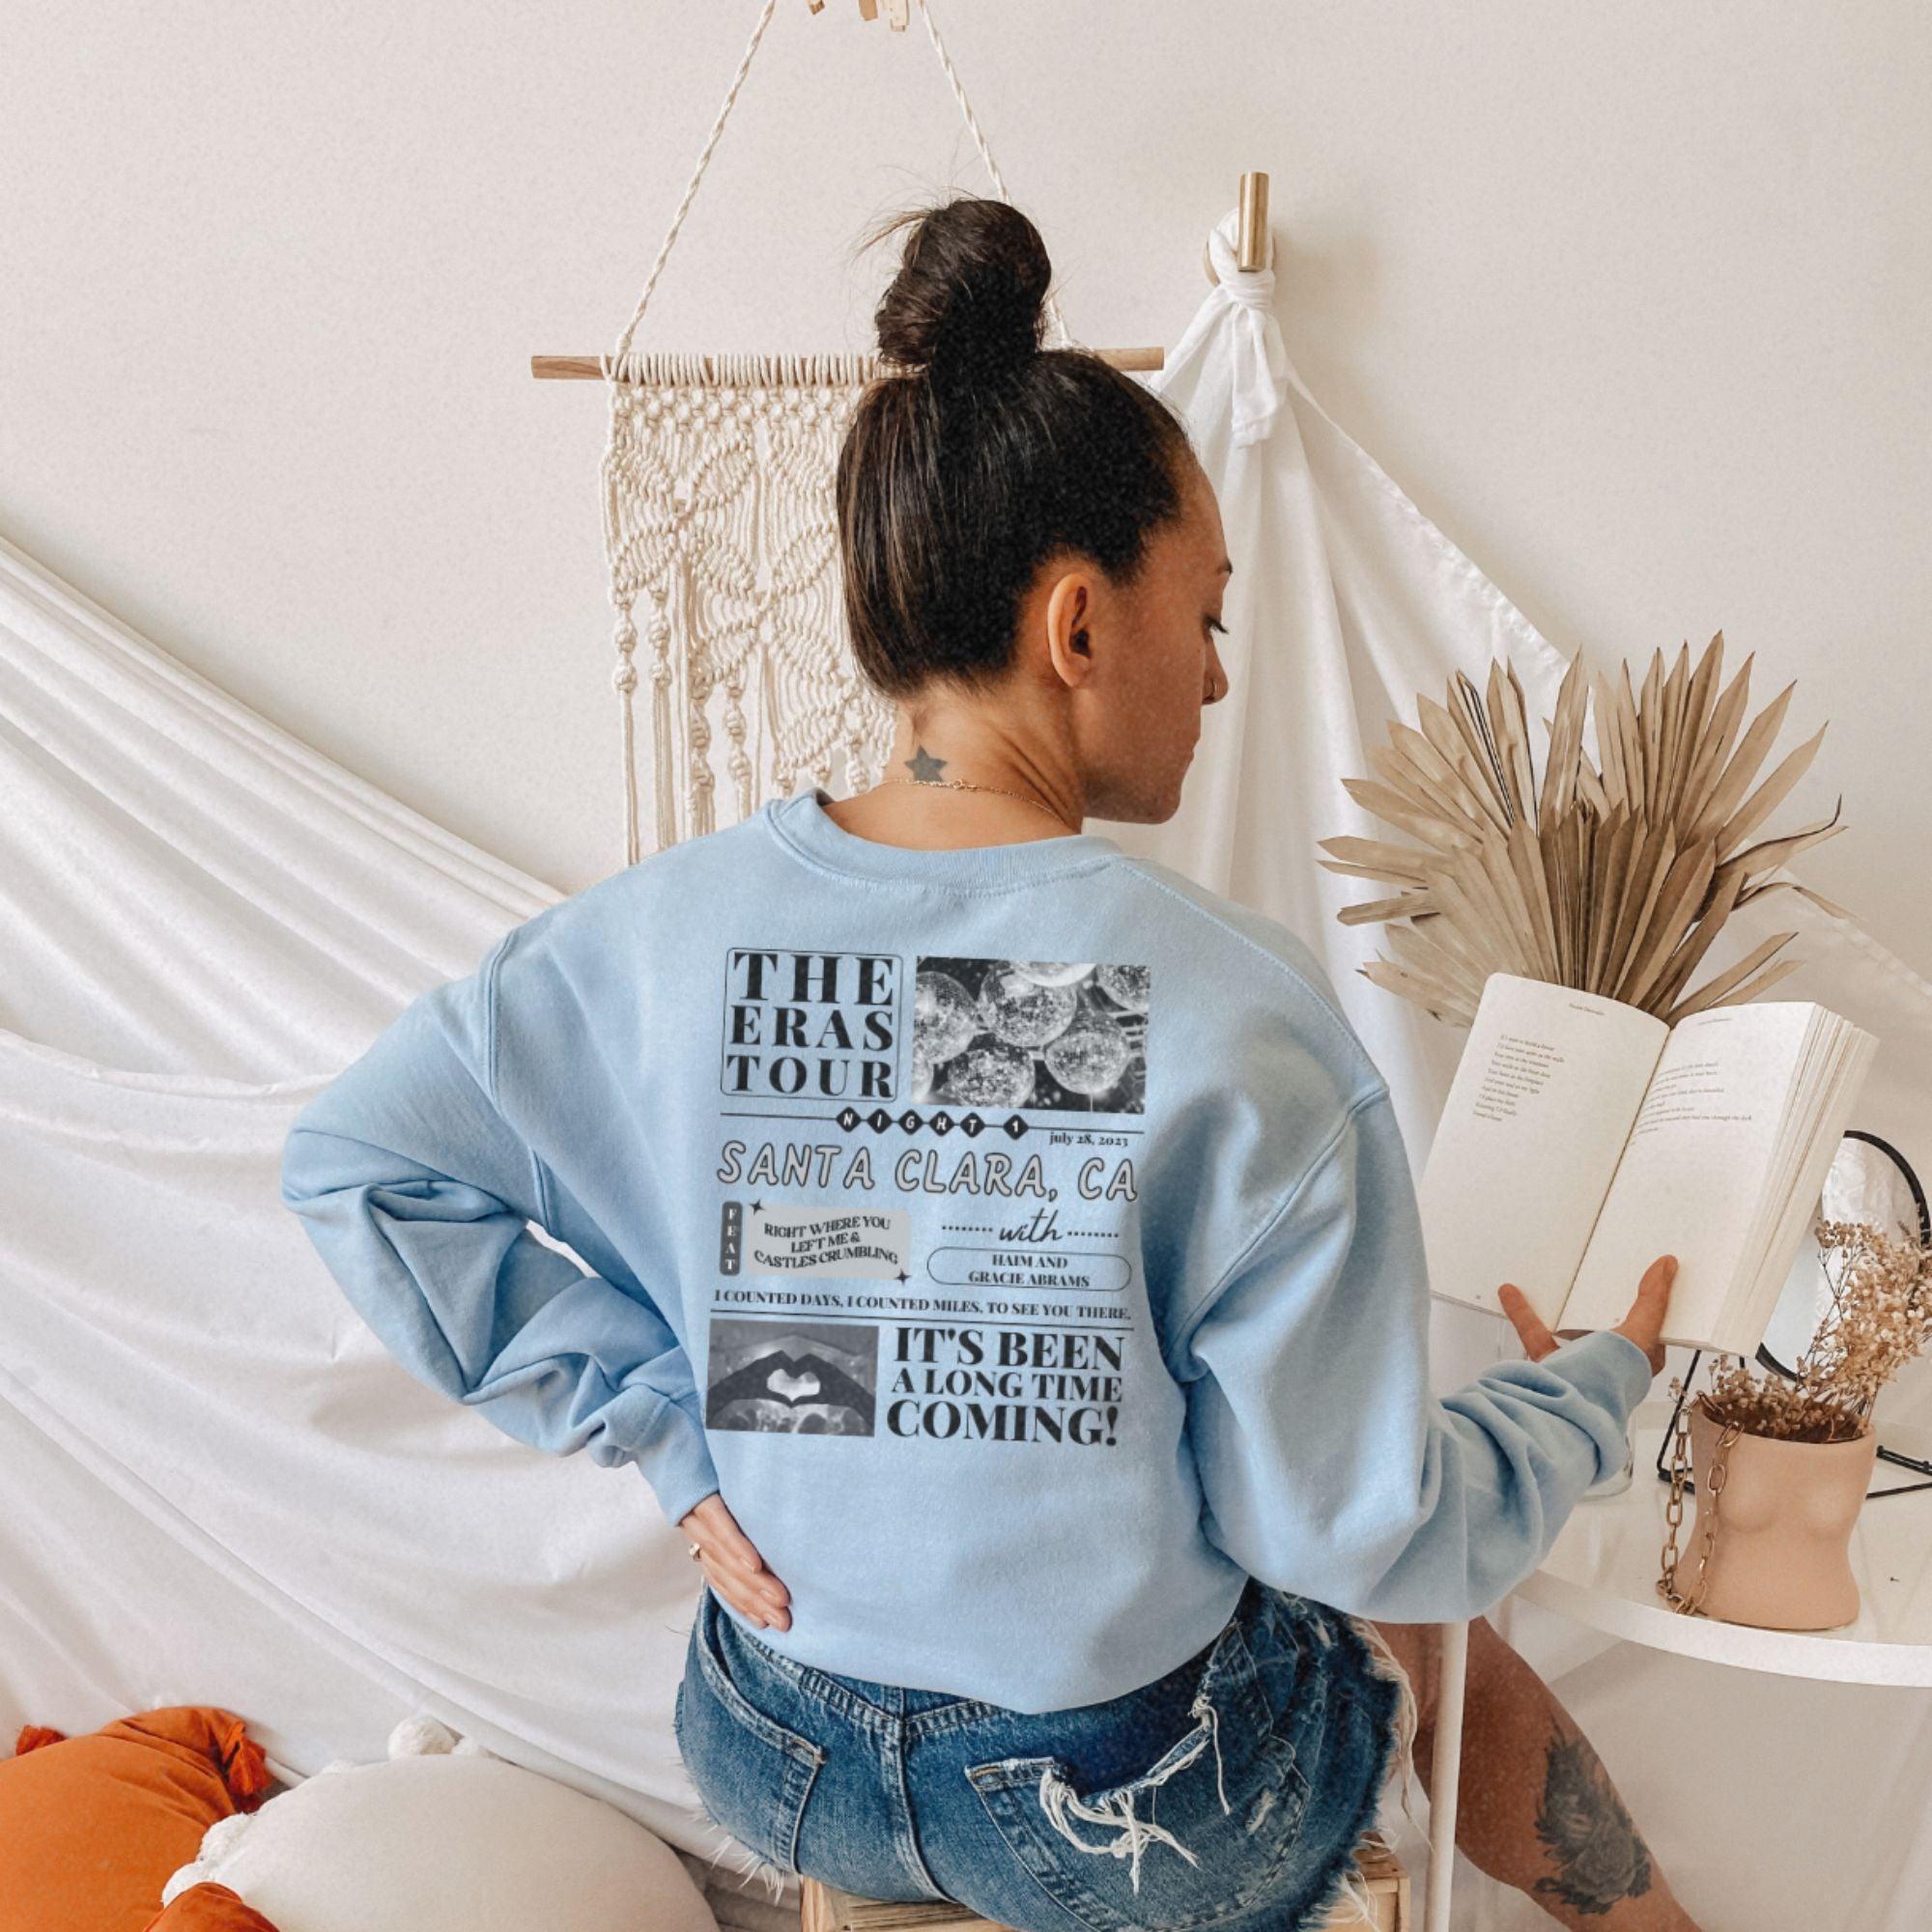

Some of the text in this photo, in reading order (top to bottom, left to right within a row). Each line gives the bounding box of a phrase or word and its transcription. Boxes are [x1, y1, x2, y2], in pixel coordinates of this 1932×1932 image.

[734, 952, 894, 1006] THE
[730, 1005, 893, 1051] ERAS
[726, 1055, 893, 1097] TOUR
[843, 1114, 977, 1132] NIGHT
[1049, 1131, 1128, 1148] july 28, 2023
[718, 1140, 1138, 1203] SANTA CLARA, CA
[724, 1208, 738, 1270] FEAT
[764, 1215, 892, 1238] RIGHT WHERE YOU
[999, 1207, 1064, 1243] with
[753, 1246, 899, 1268] CASTLES CRUMBLING
[790, 1232, 862, 1254] LEFT ME &
[968, 1270, 1090, 1288] GRACIE ABRAMS
[992, 1254, 1067, 1269] HAIM AND
[714, 1290, 721, 1302] I
[724, 1290, 798, 1305] COUNTED
[800, 1293, 844, 1308] DAYS,
[847, 1295, 854, 1308] I
[856, 1295, 929, 1312] COUNTED
[986, 1301, 1009, 1315] TO
[1011, 1303, 1039, 1317] SEE
[1041, 1304, 1071, 1318] YOU
[894, 1326, 1125, 1372] IT'S BEEN
[892, 1368, 1122, 1403] A LONG TIME
[887, 1399, 1119, 1447] COMING!
